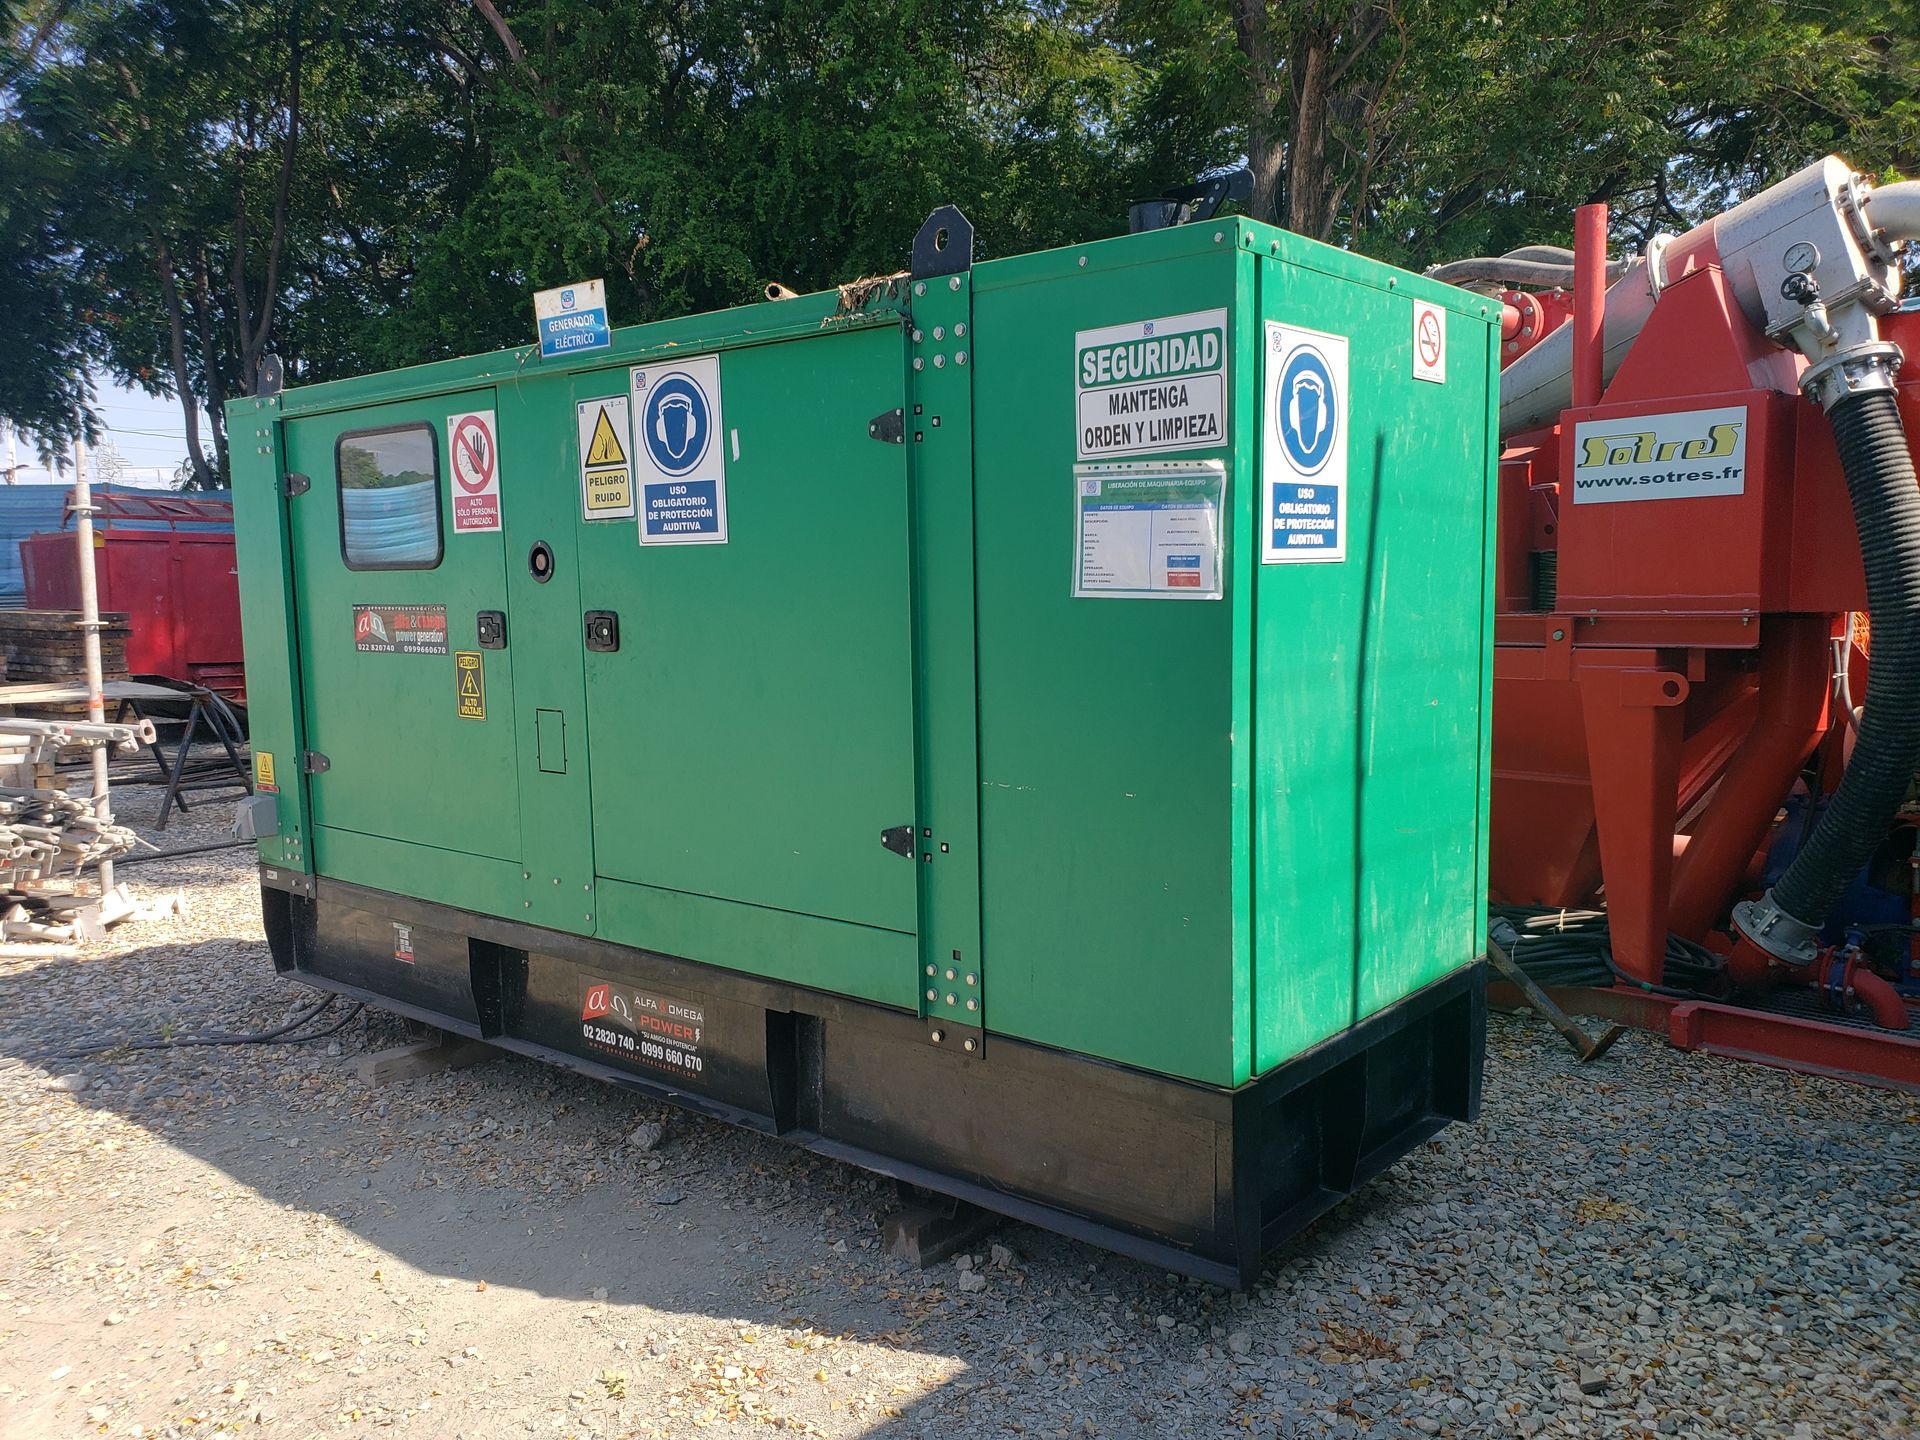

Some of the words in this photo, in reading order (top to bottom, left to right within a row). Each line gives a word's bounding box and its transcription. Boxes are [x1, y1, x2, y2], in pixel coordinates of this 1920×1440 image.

[549, 313, 596, 332] GENERADOR
[555, 331, 595, 349] ELÉCTRICO
[1082, 333, 1219, 385] SEGURIDAD
[1109, 384, 1189, 416] MANTENGA
[1085, 422, 1131, 449] ORDEN
[1135, 421, 1145, 443] Y
[1149, 413, 1218, 442] LIMPIEZA
[589, 474, 626, 487] PELIGRO
[1576, 466, 1743, 489] www.sotres.fr
[669, 485, 687, 495] USO
[1297, 487, 1315, 499] USO
[470, 498, 483, 507] ALTO
[595, 491, 622, 503] RUIDO
[652, 496, 707, 508] OBLIGATORIO
[471, 507, 498, 516] PERSONAL
[648, 511, 659, 520] DE
[660, 506, 713, 519] PROTECCIÓN
[1279, 501, 1331, 515] OBLIGATORIO
[463, 516, 493, 526] AUTORIZADO
[663, 521, 701, 532] AUDITIVA
[1273, 518, 1287, 530] DE
[1287, 516, 1335, 531] PROTECCIÓN
[1287, 532, 1324, 545] AUDITIVA
[395, 631, 416, 643] power
[358, 643, 370, 651] 022
[371, 644, 395, 652] 820740
[403, 645, 447, 654] 0999660670
[465, 697, 478, 706] ALTO
[461, 705, 483, 716] VOLTAJE
[634, 996, 658, 1010] ALFA
[668, 1004, 704, 1022] OMEGA
[640, 1015, 693, 1040] POWER
[583, 1024, 594, 1039] 02
[595, 1027, 616, 1046] 2820
[618, 1033, 634, 1051] 740
[641, 1041, 664, 1060] 0999
[666, 1050, 682, 1066] 660
[685, 1054, 702, 1071] 670
